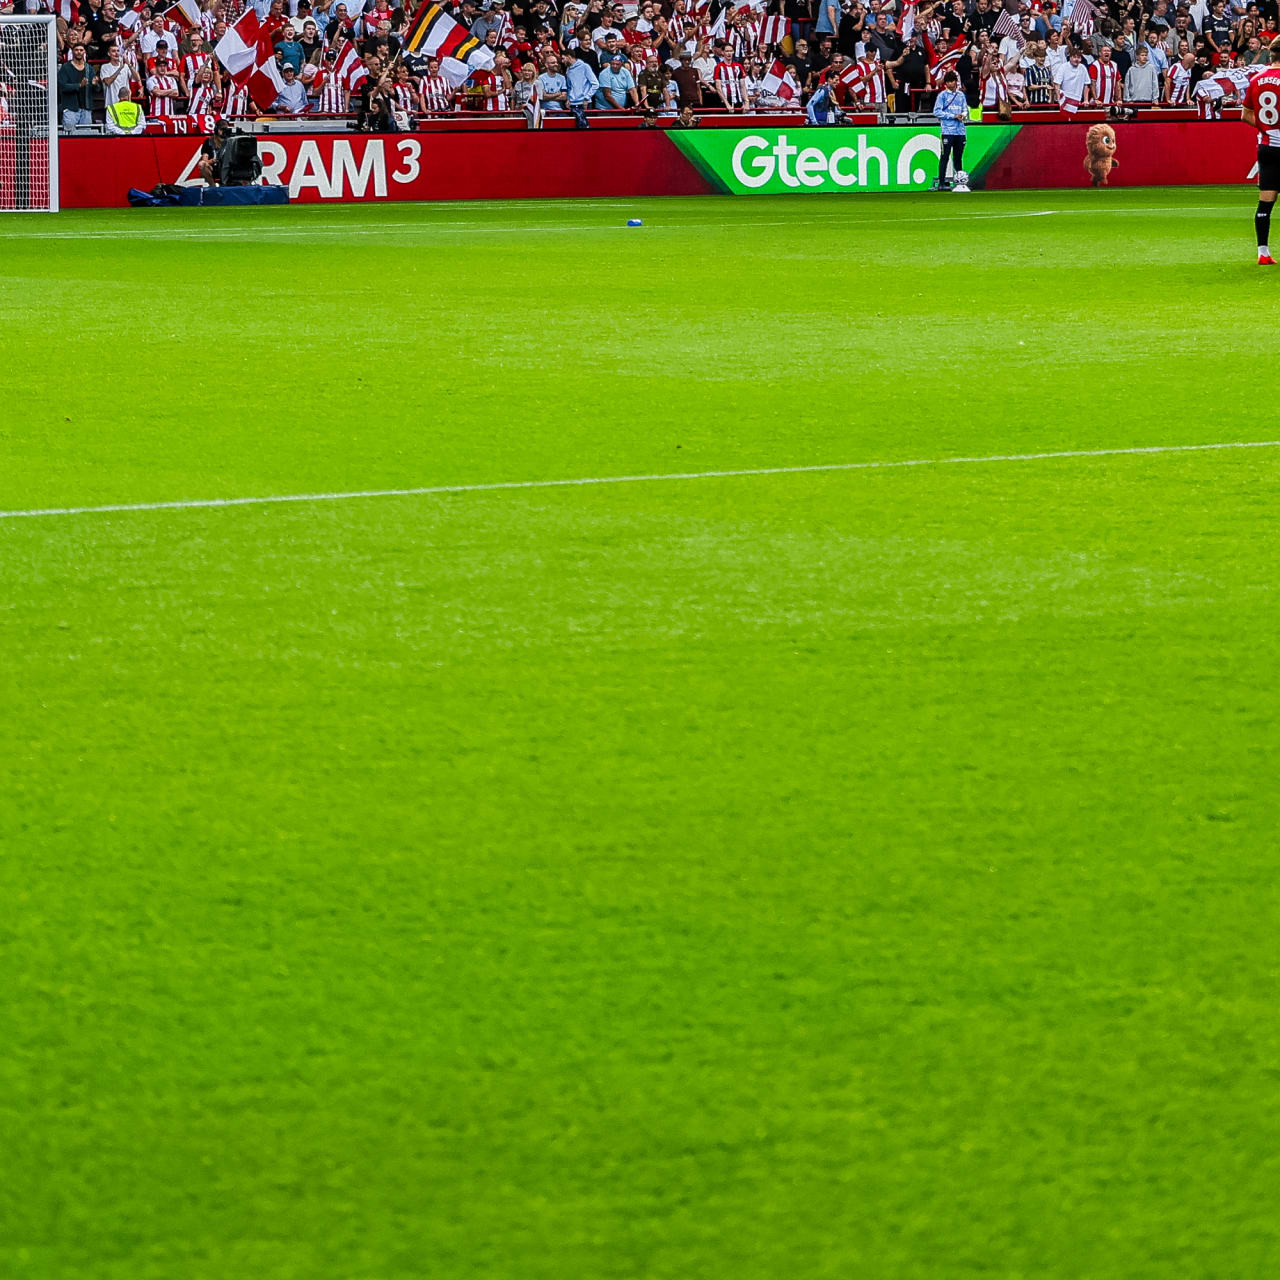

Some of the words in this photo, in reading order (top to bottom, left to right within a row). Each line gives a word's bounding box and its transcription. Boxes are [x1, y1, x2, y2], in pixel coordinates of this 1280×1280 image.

[1258, 91, 1280, 126] 8
[172, 119, 187, 135] 14
[204, 114, 216, 130] 8
[732, 134, 889, 188] Gtech
